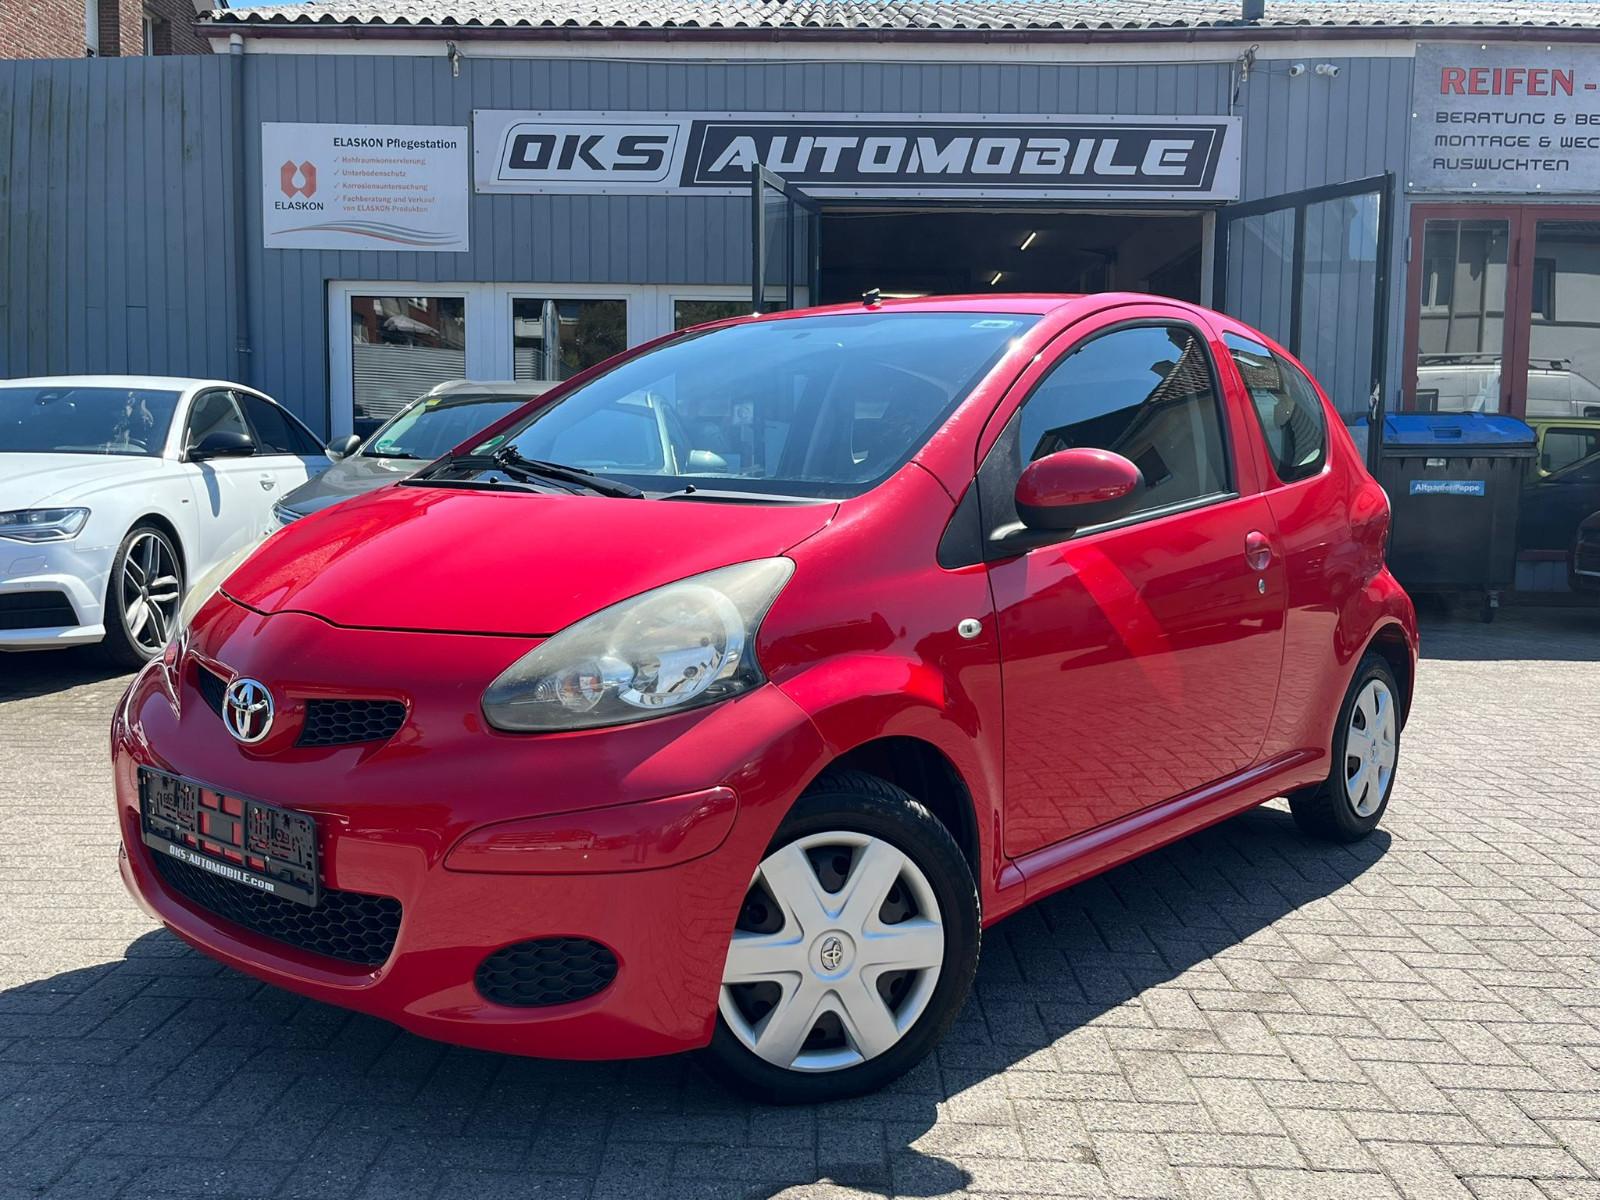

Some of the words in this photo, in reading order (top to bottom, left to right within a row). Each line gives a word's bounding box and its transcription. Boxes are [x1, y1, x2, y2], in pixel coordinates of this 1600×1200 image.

[1440, 67, 1574, 96] REIFEN
[1435, 111, 1545, 124] BERATUNG
[1553, 113, 1566, 125] &
[1575, 113, 1600, 125] BE
[333, 137, 383, 148] ELASKON
[386, 138, 457, 150] Pflegestation
[1434, 135, 1530, 147] MONTAGE
[1538, 136, 1552, 148] &
[1560, 137, 1600, 149] WEC
[508, 134, 669, 171] OKS
[707, 135, 1195, 176] AUTOMOBILE
[1432, 158, 1569, 171] AUSWUCHTEN
[274, 201, 324, 211] ELASKON
